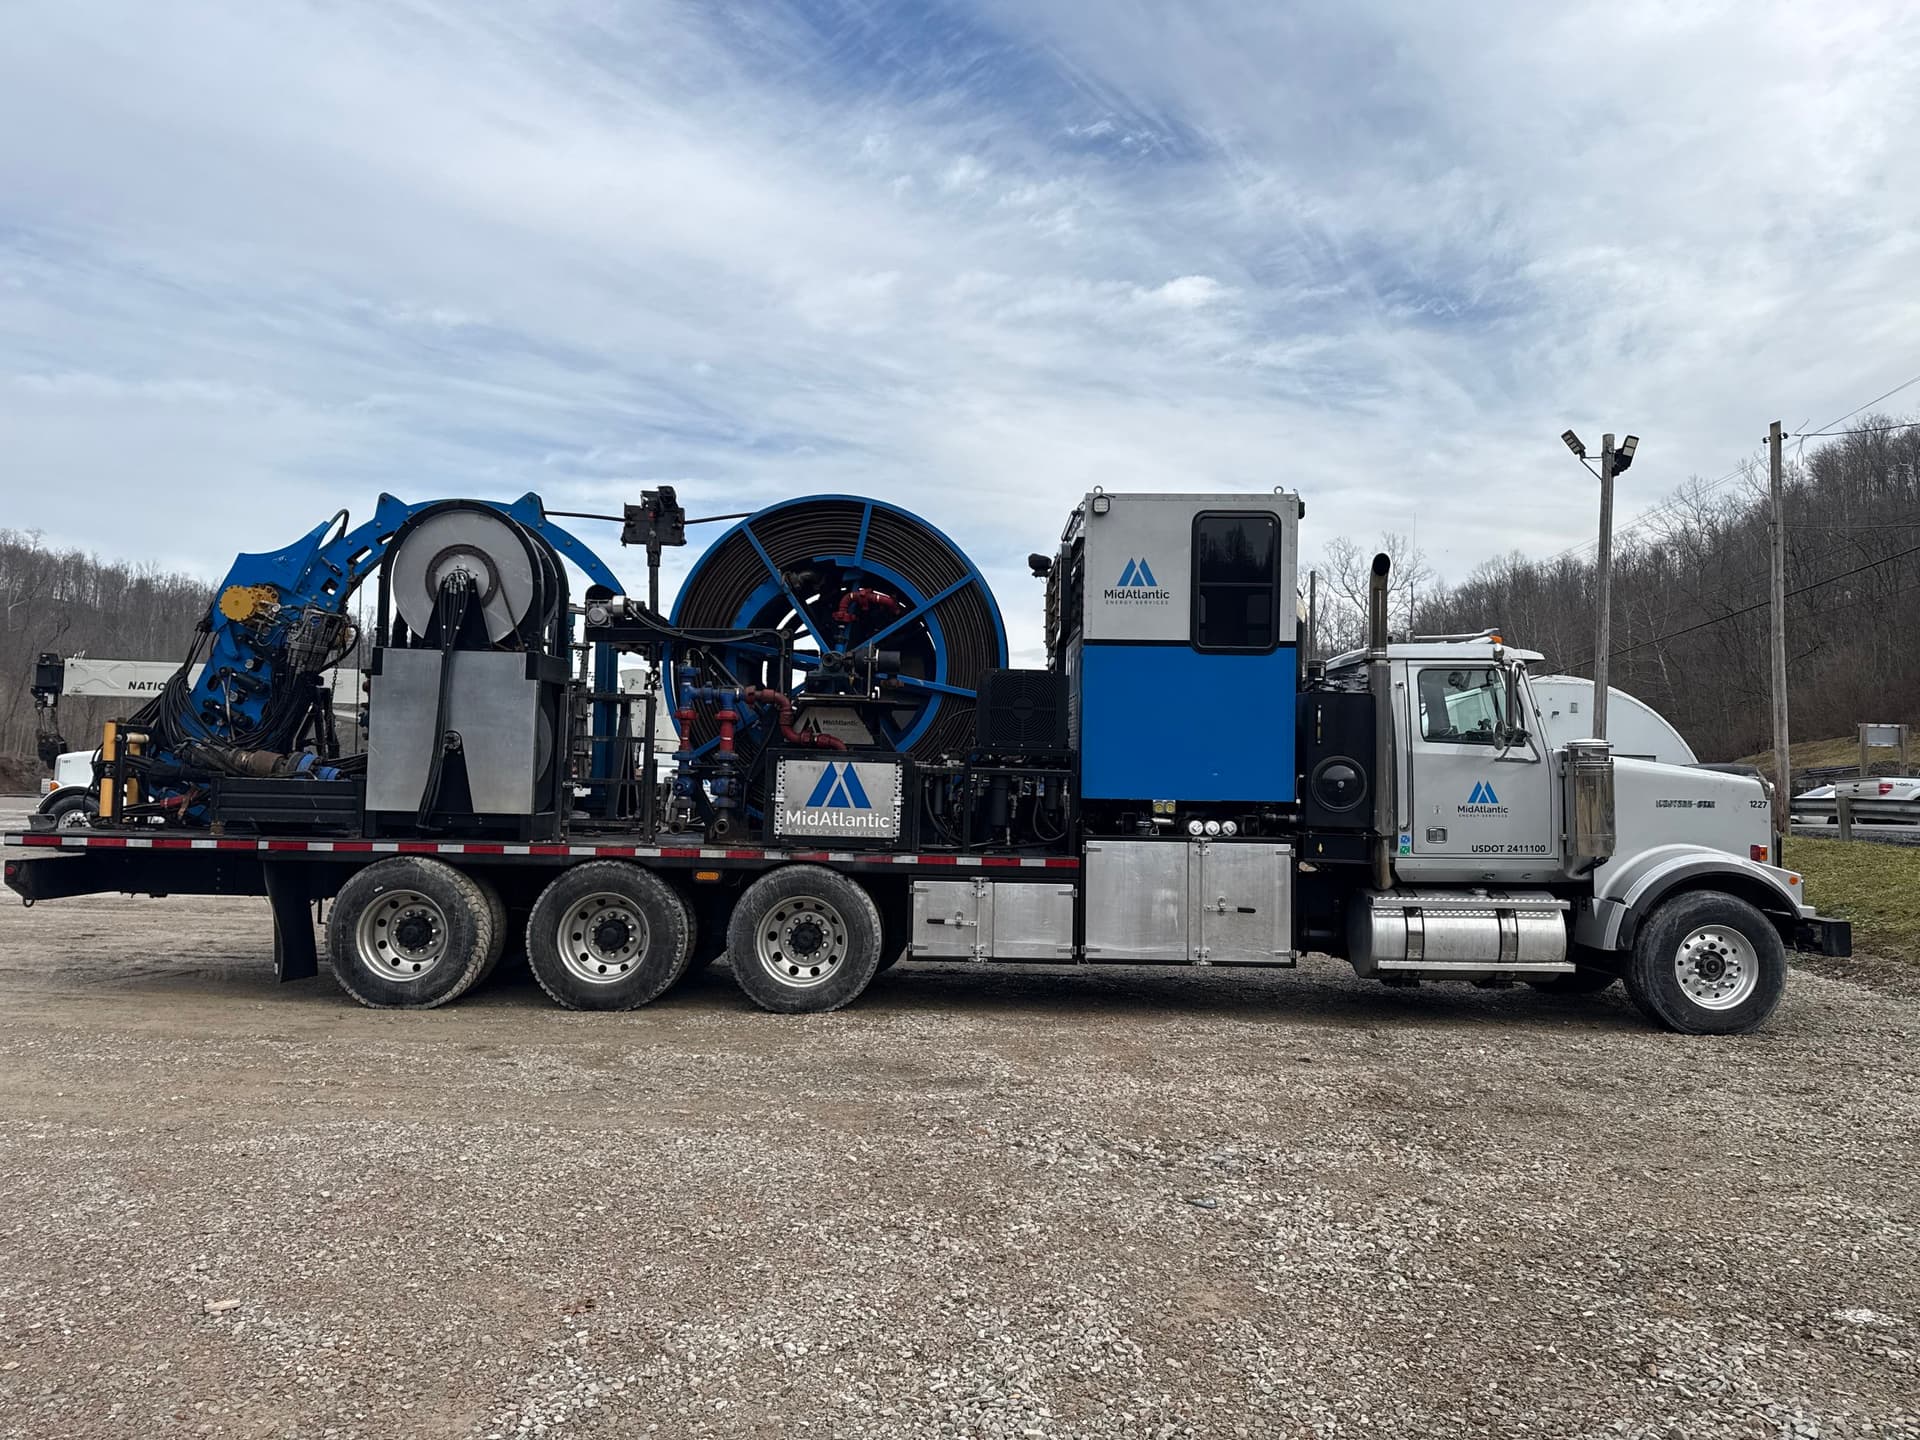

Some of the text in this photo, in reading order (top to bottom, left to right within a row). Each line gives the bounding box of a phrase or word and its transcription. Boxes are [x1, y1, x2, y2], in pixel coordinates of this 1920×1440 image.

[1104, 589, 1170, 600] MidAtlantic
[1457, 805, 1509, 813] MidAtlantic
[1749, 801, 1768, 809] 1227
[786, 810, 890, 828] MidAtlantic
[1472, 845, 1546, 853] USDOT 2411100
